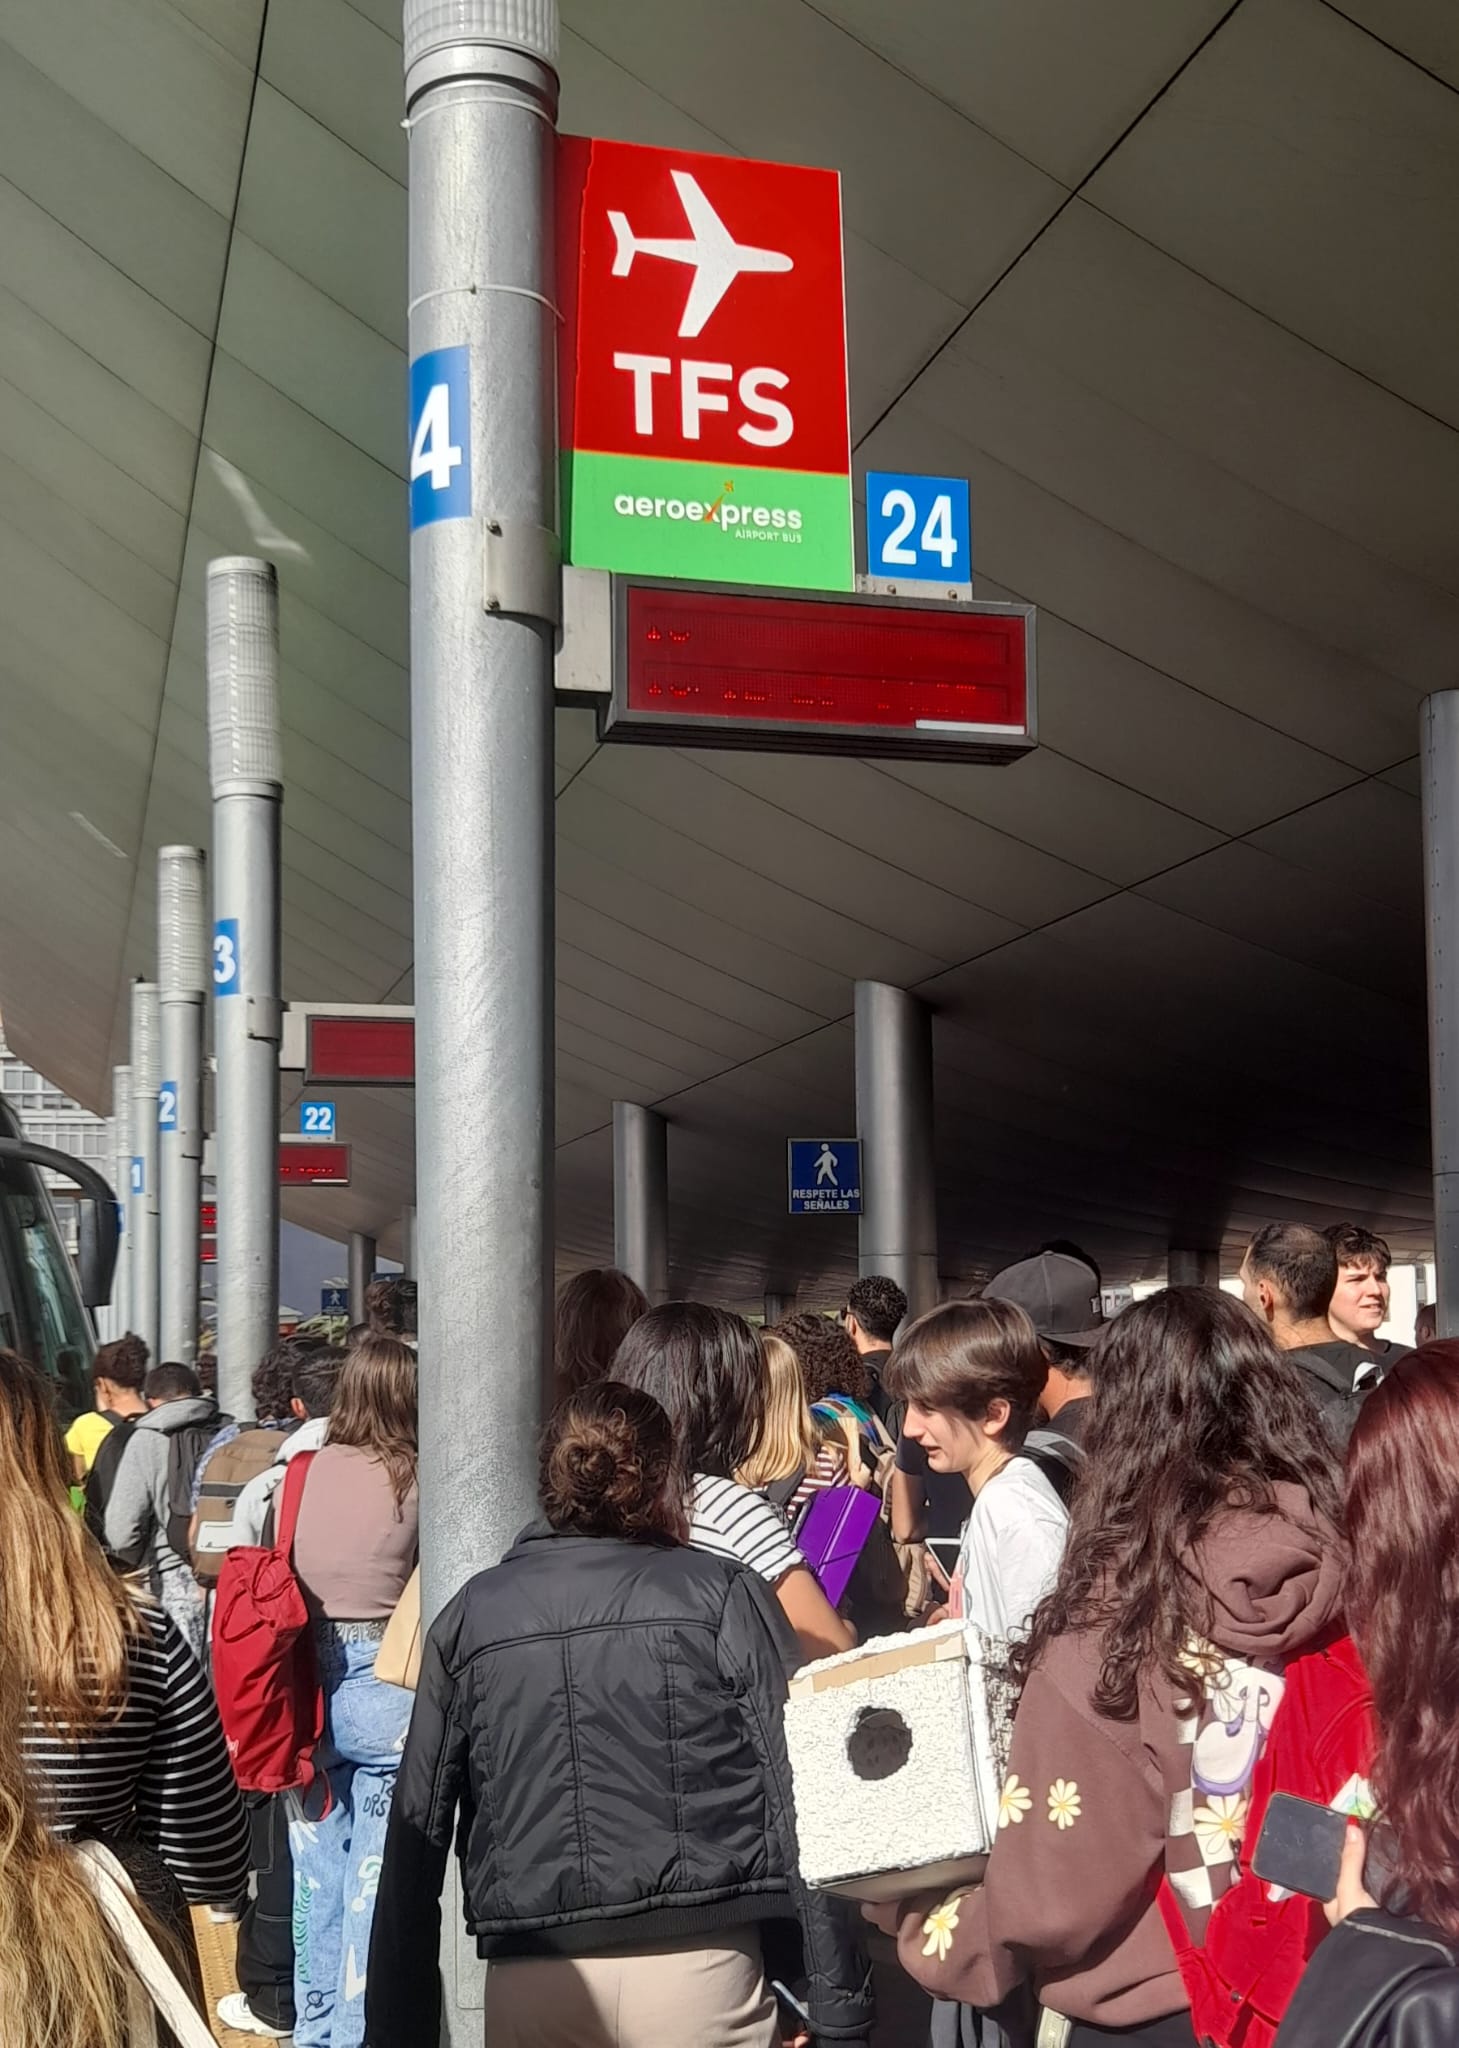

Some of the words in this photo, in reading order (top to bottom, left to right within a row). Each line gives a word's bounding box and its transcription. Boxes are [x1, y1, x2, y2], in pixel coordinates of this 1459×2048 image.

[613, 351, 795, 448] TFS
[411, 383, 462, 490] 4
[614, 493, 803, 532] aeroexpress
[881, 488, 958, 568] 24
[735, 529, 780, 542] AIRPORT
[782, 533, 803, 544] BUS
[214, 934, 236, 984] 3
[159, 1090, 176, 1123] 2
[305, 1106, 332, 1131] 22
[792, 1189, 839, 1199] RESPETE
[840, 1188, 861, 1199] LAS
[803, 1198, 850, 1211] SEÑALES
